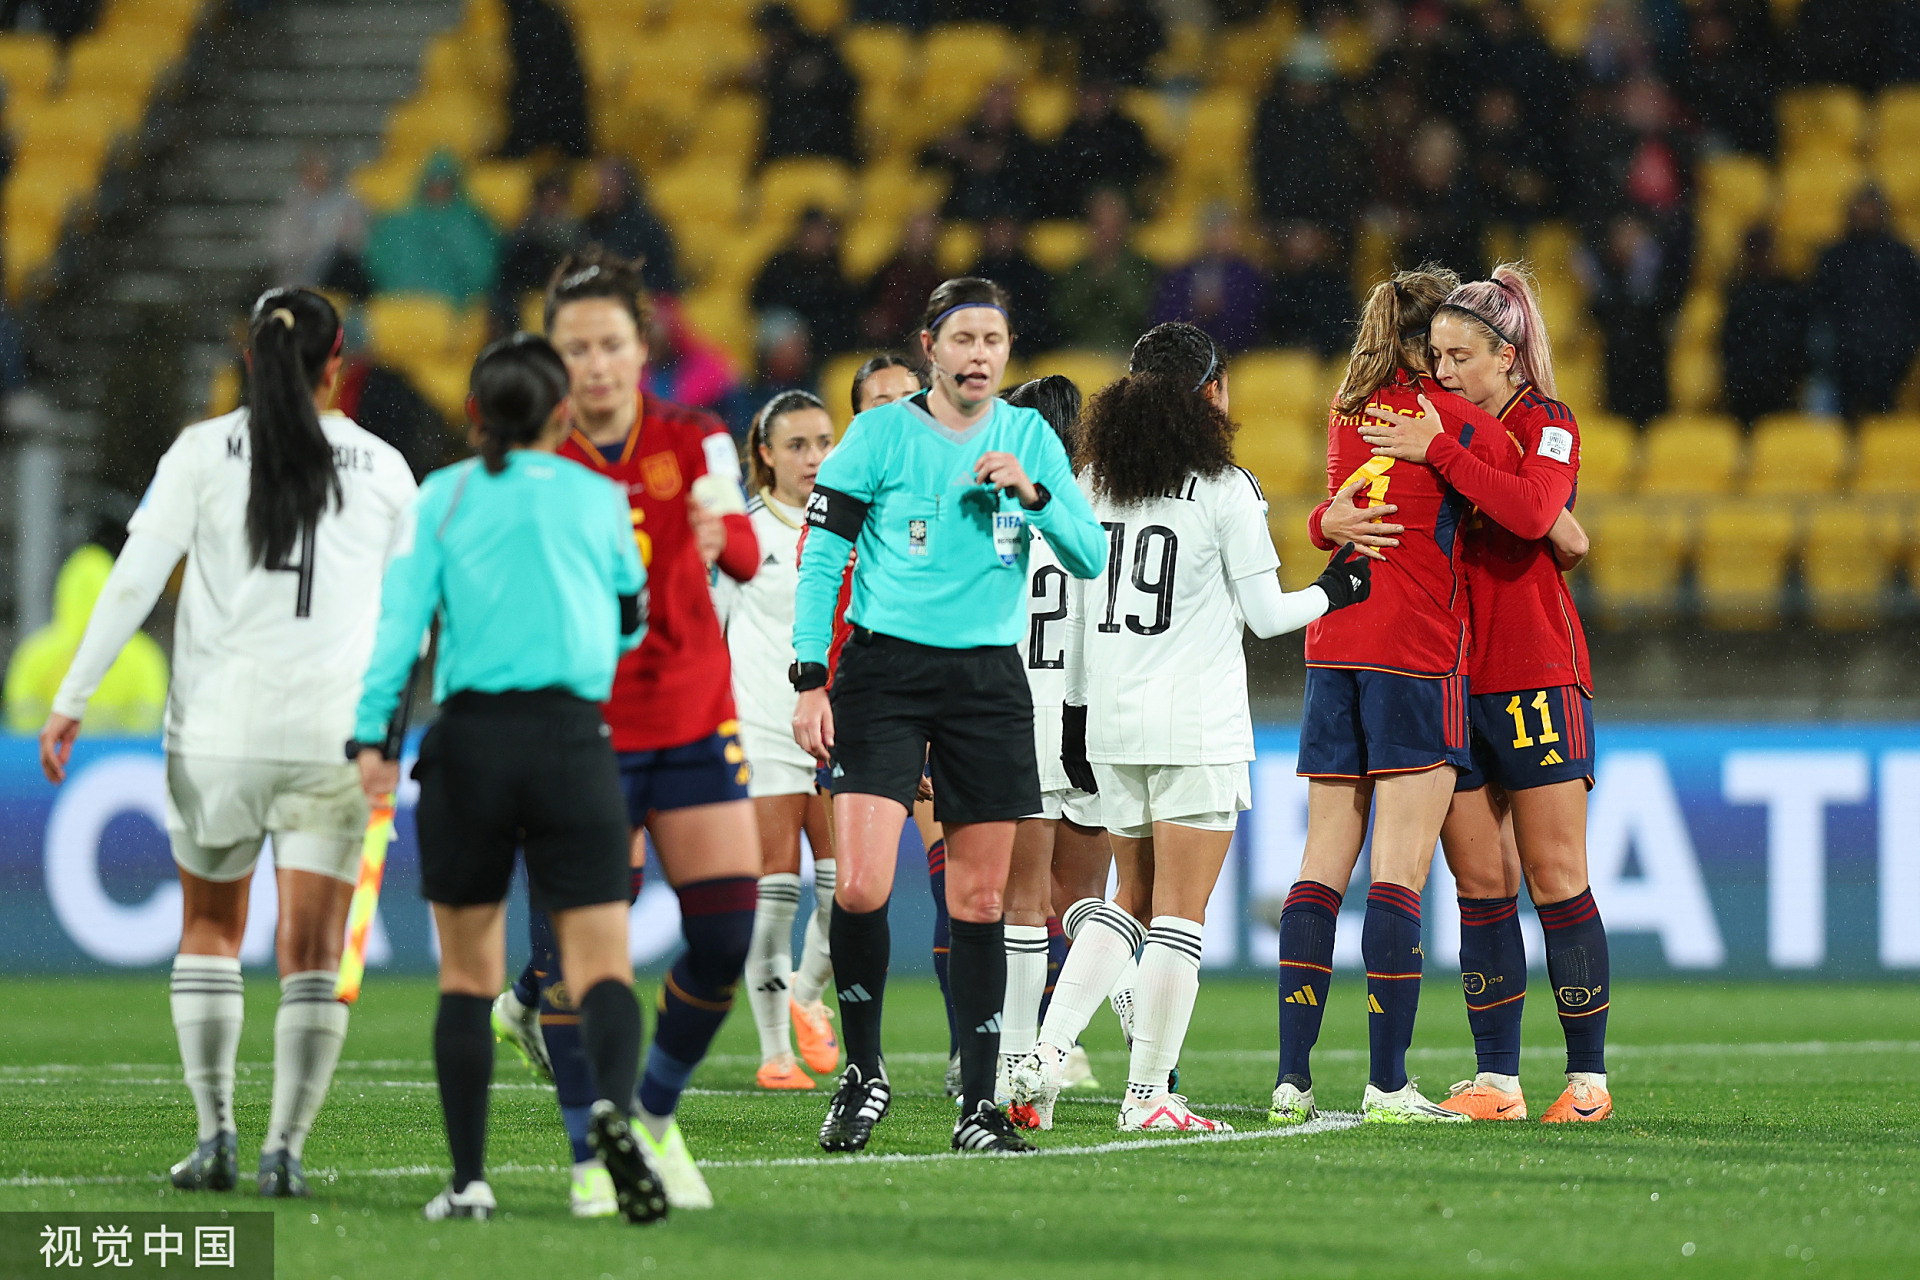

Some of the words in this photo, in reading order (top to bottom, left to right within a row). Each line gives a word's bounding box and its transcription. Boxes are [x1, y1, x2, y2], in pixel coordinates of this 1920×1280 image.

[806, 491, 829, 513] FA
[997, 516, 1022, 528] FIFA
[264, 515, 317, 618] 4
[1098, 521, 1178, 636] 19
[1505, 690, 1560, 749] 11
